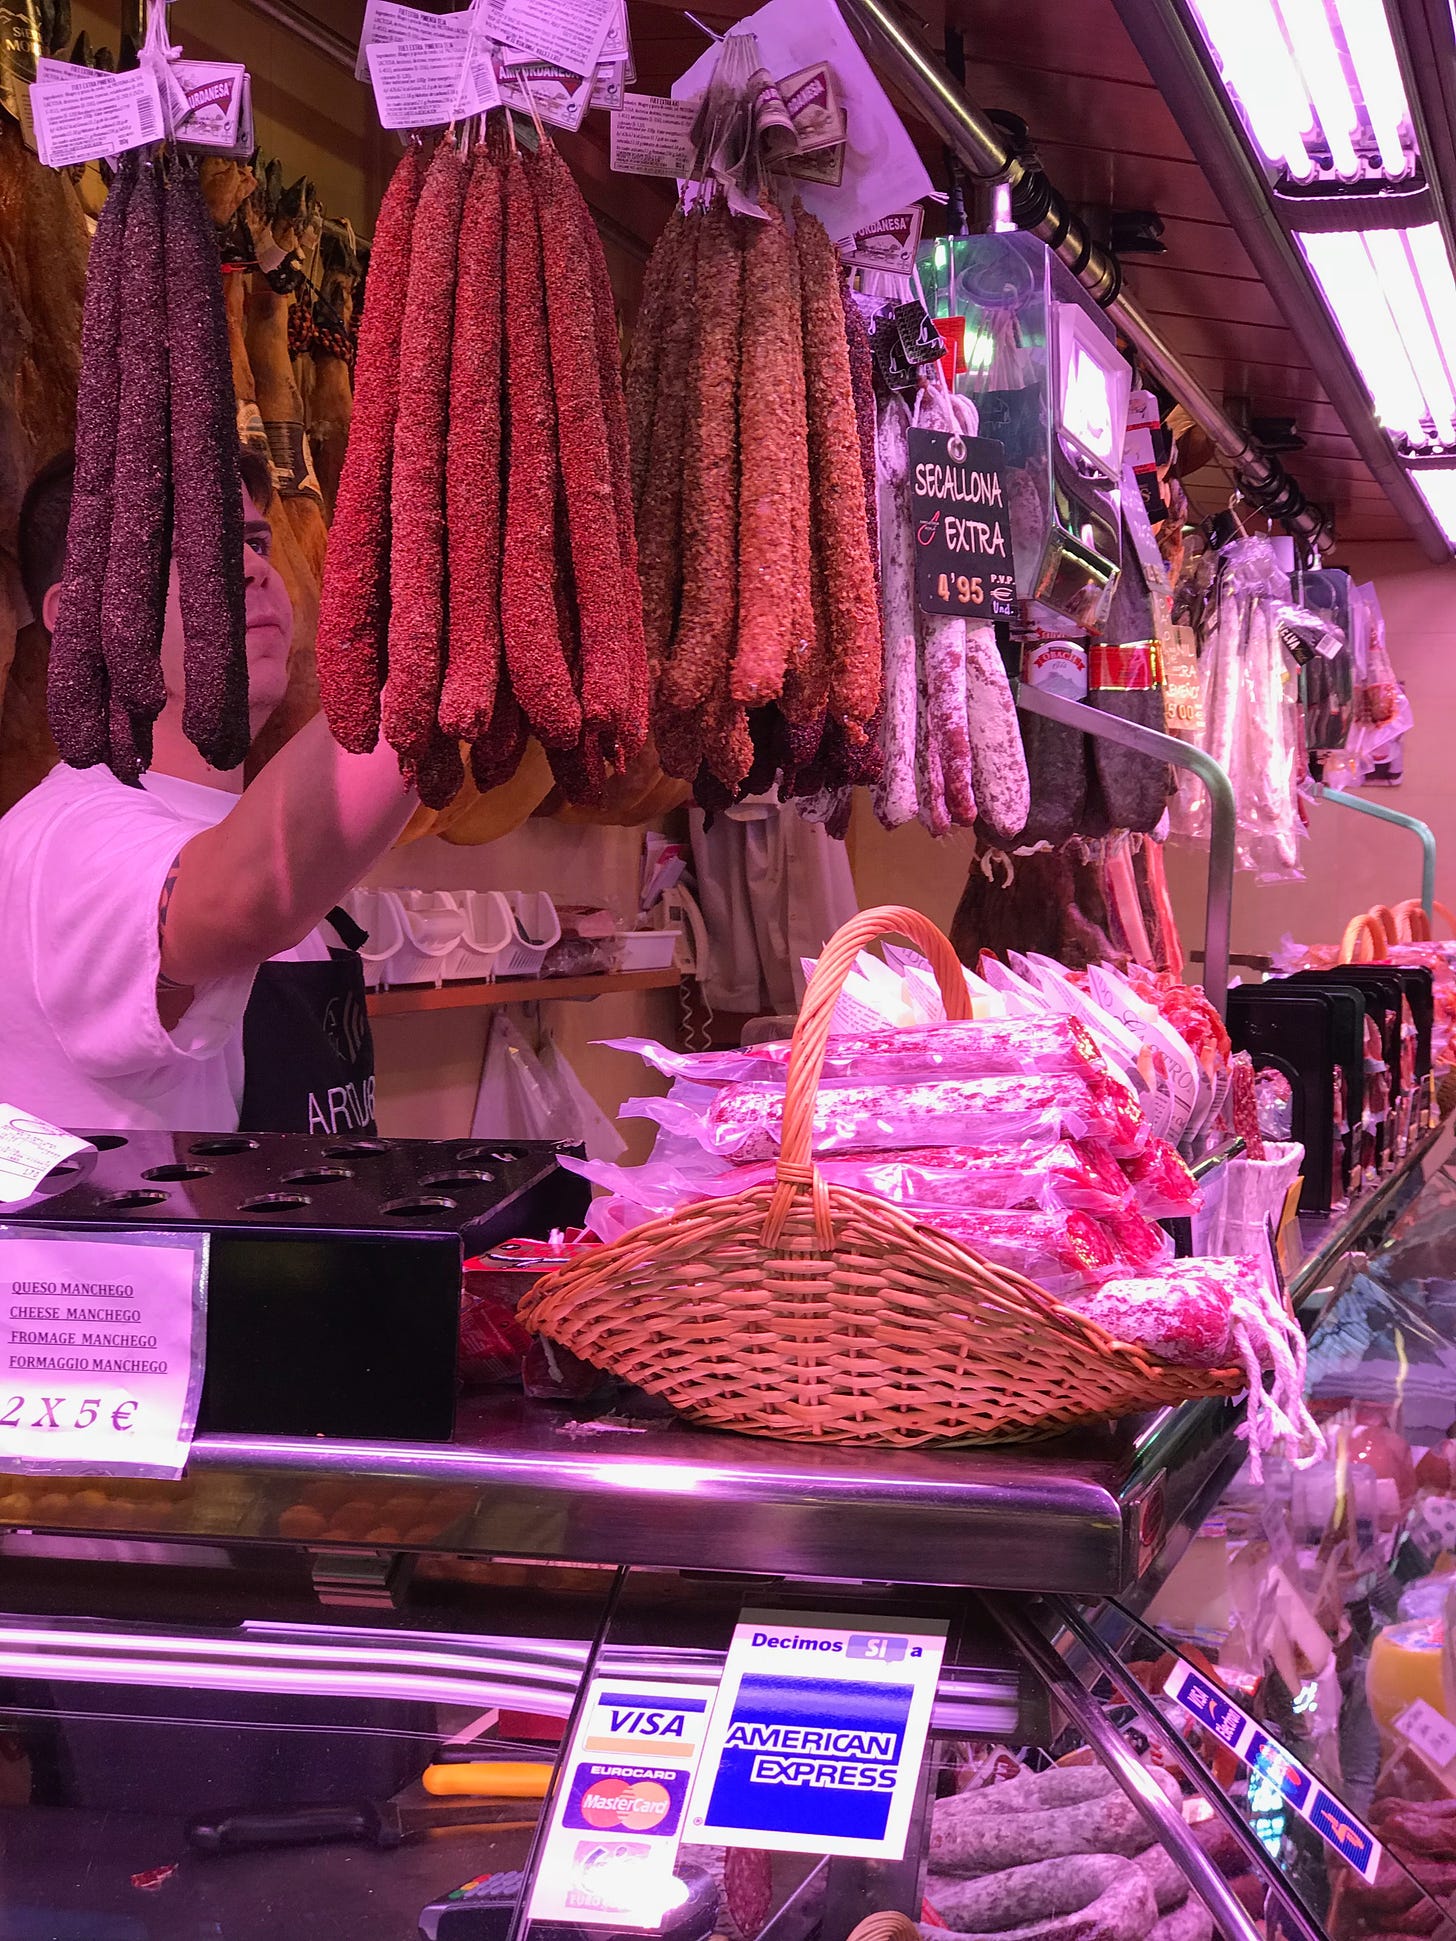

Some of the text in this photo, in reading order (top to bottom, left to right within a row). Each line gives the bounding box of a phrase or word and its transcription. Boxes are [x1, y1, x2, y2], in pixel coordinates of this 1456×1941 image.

[188, 82, 230, 109] URDANESA
[858, 217, 907, 237] URDANESA
[914, 462, 1003, 509] SECALLONA
[944, 516, 1006, 558] EXTRA
[936, 572, 985, 605] 4'95
[12, 1281, 134, 1297] QUESO MANCHEGO
[9, 1306, 141, 1322] CHEESE MANCHEGO
[11, 1330, 157, 1348] FROMAGE MANCHEGO
[9, 1355, 168, 1373] FORMAGGIO MANCHEGO
[751, 1632, 923, 1658] Decimos SI a
[1187, 1685, 1210, 1710] VISA
[609, 1710, 686, 1737] VISA
[1215, 1708, 1242, 1742] Electron
[724, 1724, 893, 1757] AMERICAN
[590, 1765, 677, 1780] EUROCARD
[755, 1758, 898, 1788] EXPRESS
[583, 1794, 668, 1815] MasterCard
